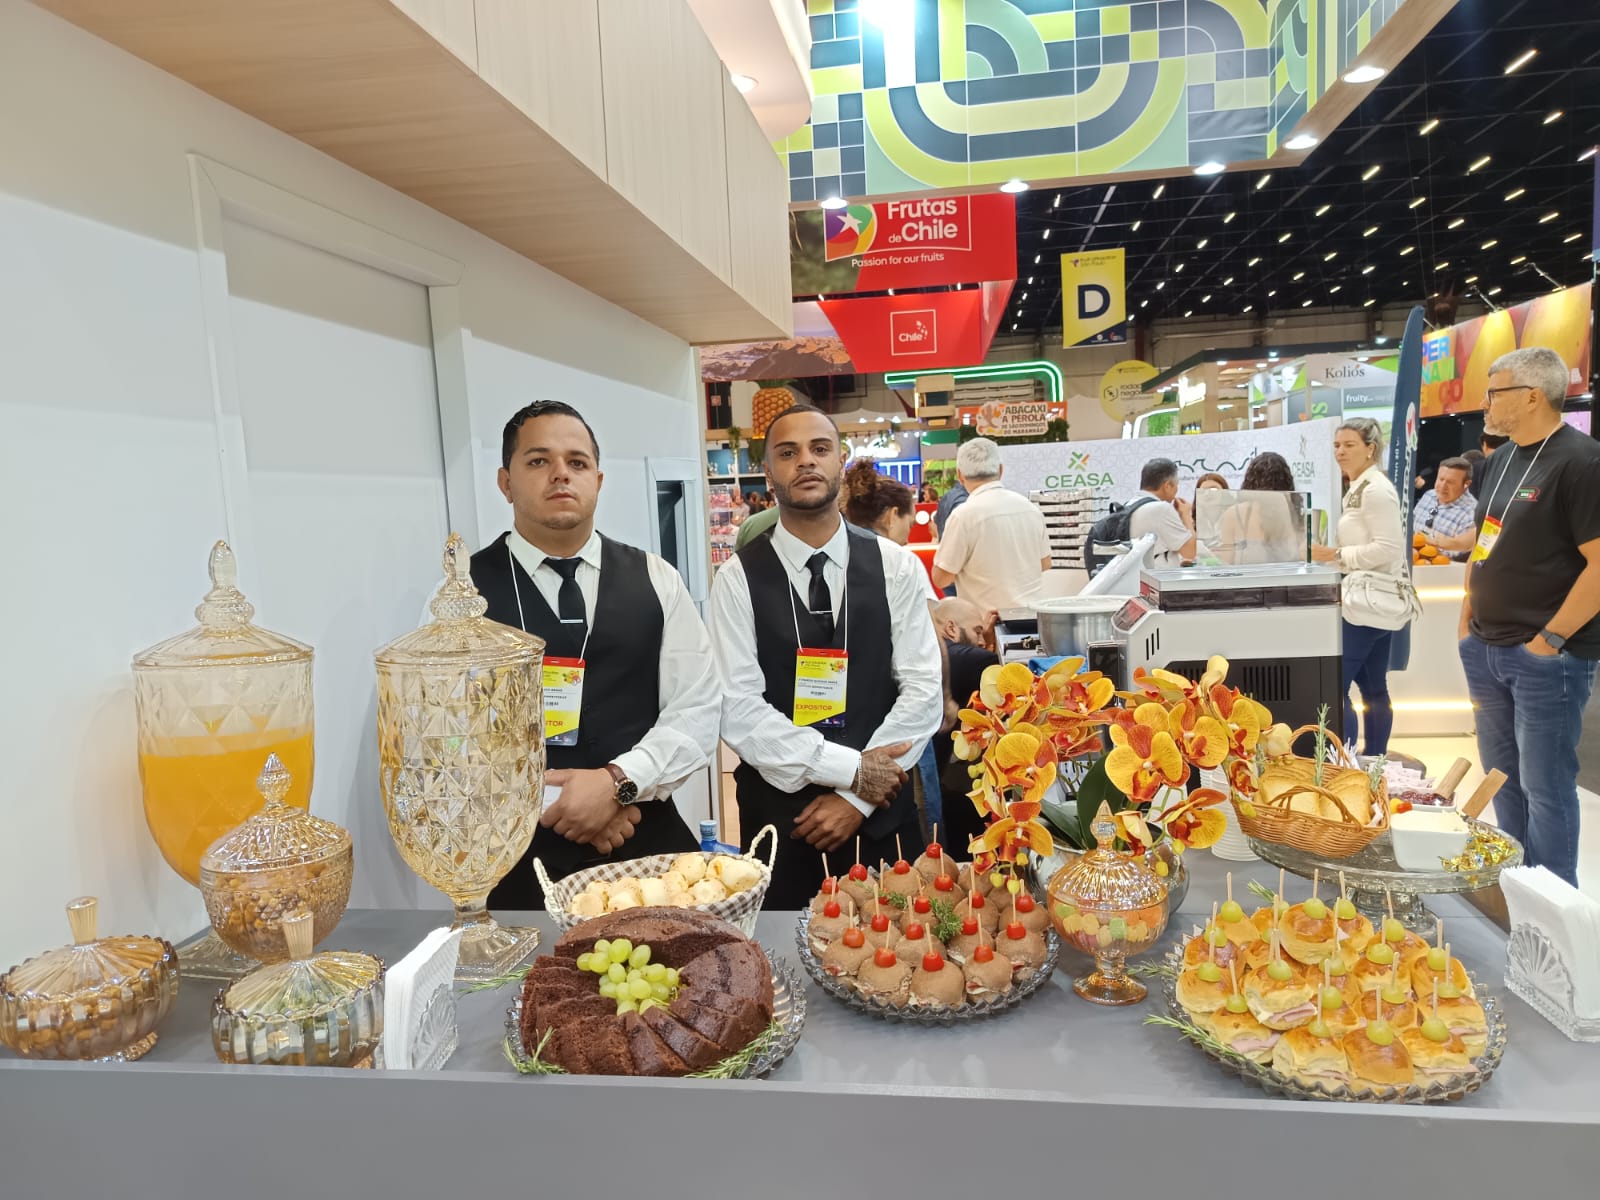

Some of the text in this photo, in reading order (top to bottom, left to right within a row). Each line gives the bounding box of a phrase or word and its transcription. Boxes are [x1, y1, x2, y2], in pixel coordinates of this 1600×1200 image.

[887, 198, 957, 220] Frutas
[888, 218, 958, 244] de Chile
[851, 252, 945, 268] Passion for our fruits
[1077, 284, 1111, 319] D
[898, 332, 923, 343] Chile
[1005, 404, 1046, 415] ABACAXI
[1292, 461, 1316, 478] CEASA
[1045, 472, 1114, 489] CEASA
